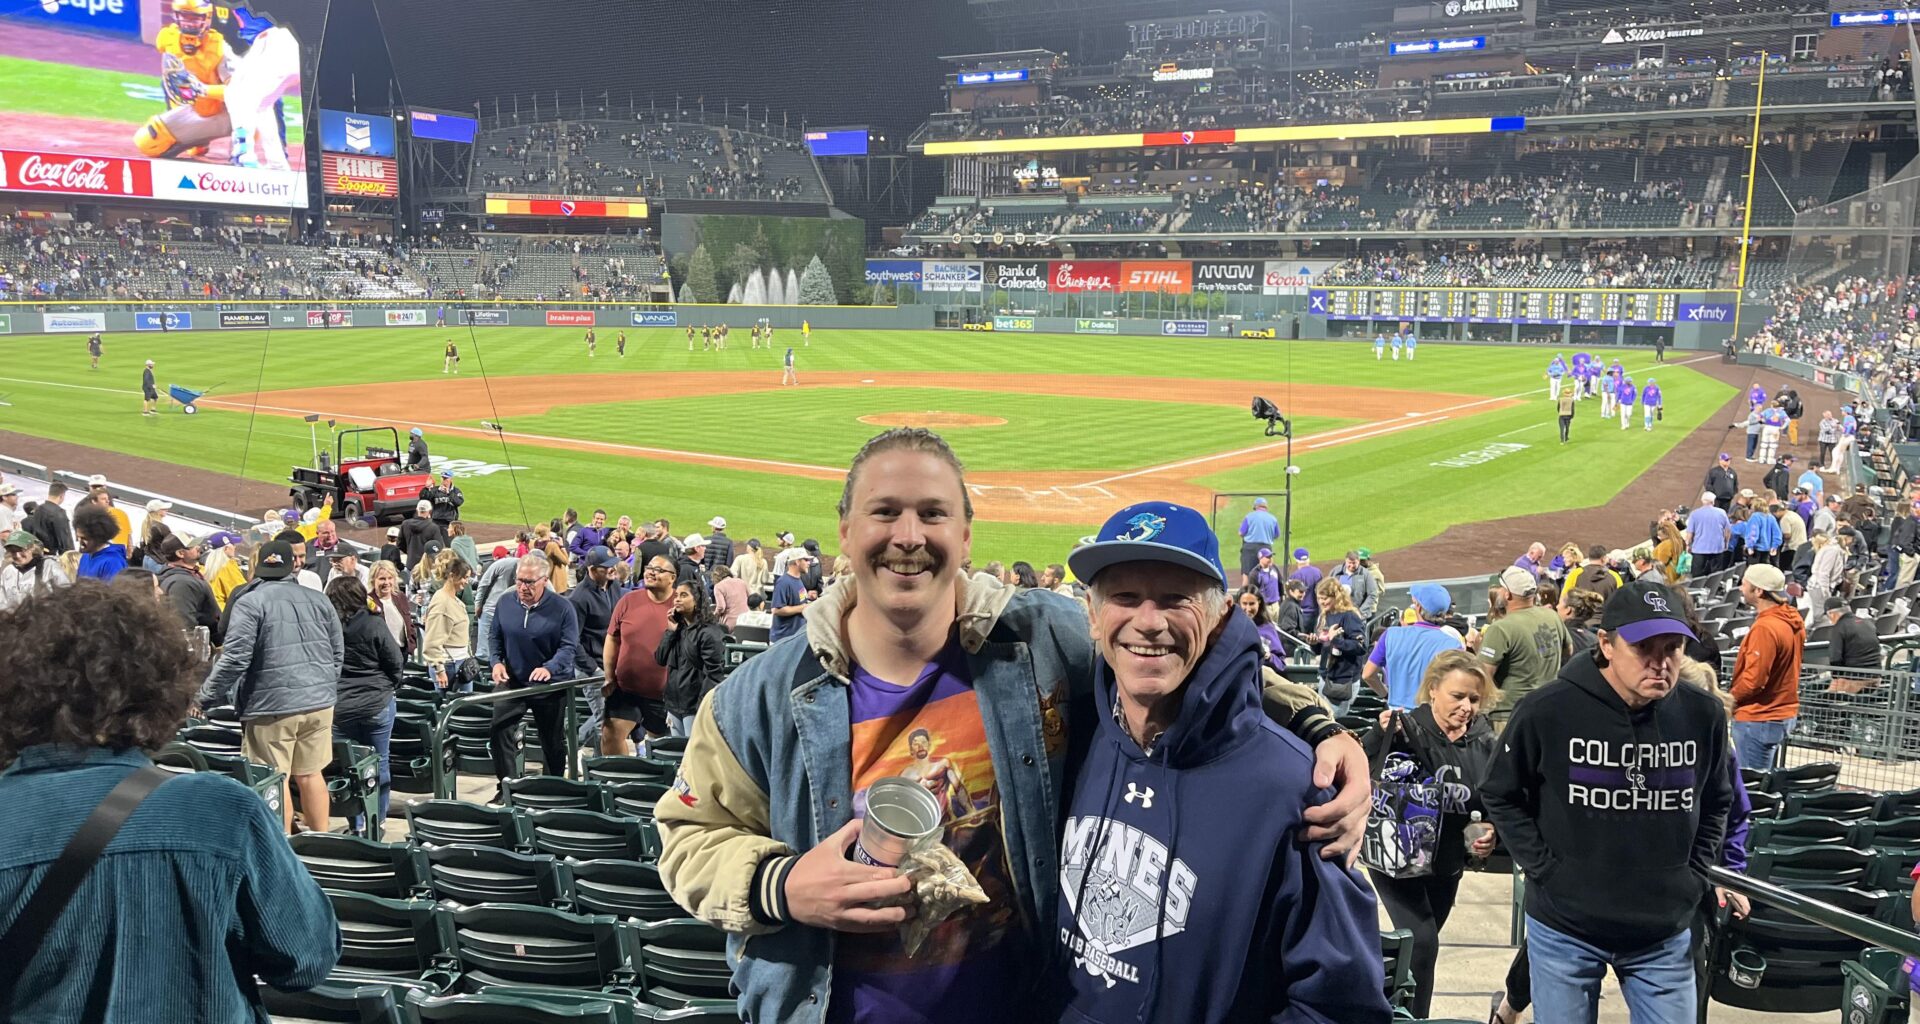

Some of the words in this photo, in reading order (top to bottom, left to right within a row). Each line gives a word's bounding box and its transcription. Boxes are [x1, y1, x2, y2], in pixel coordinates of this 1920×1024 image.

[1625, 29, 1665, 42] Silver
[345, 117, 370, 126] Chevron
[336, 158, 384, 178] KING
[198, 172, 245, 193] Coors
[248, 183, 289, 196] LIGHT
[338, 176, 386, 192] Soopers
[864, 270, 914, 281] Southwest
[999, 264, 1025, 276] Bank
[1026, 264, 1038, 276] of
[1129, 270, 1183, 284] STIHL
[998, 276, 1047, 288] Colorado
[1266, 271, 1305, 286] Coors
[1688, 306, 1727, 321] xfinity
[996, 319, 1032, 328] bet365
[1569, 738, 1696, 768] COLORADO
[1060, 816, 1198, 928] MINES
[1084, 940, 1140, 984] BASEBALL
